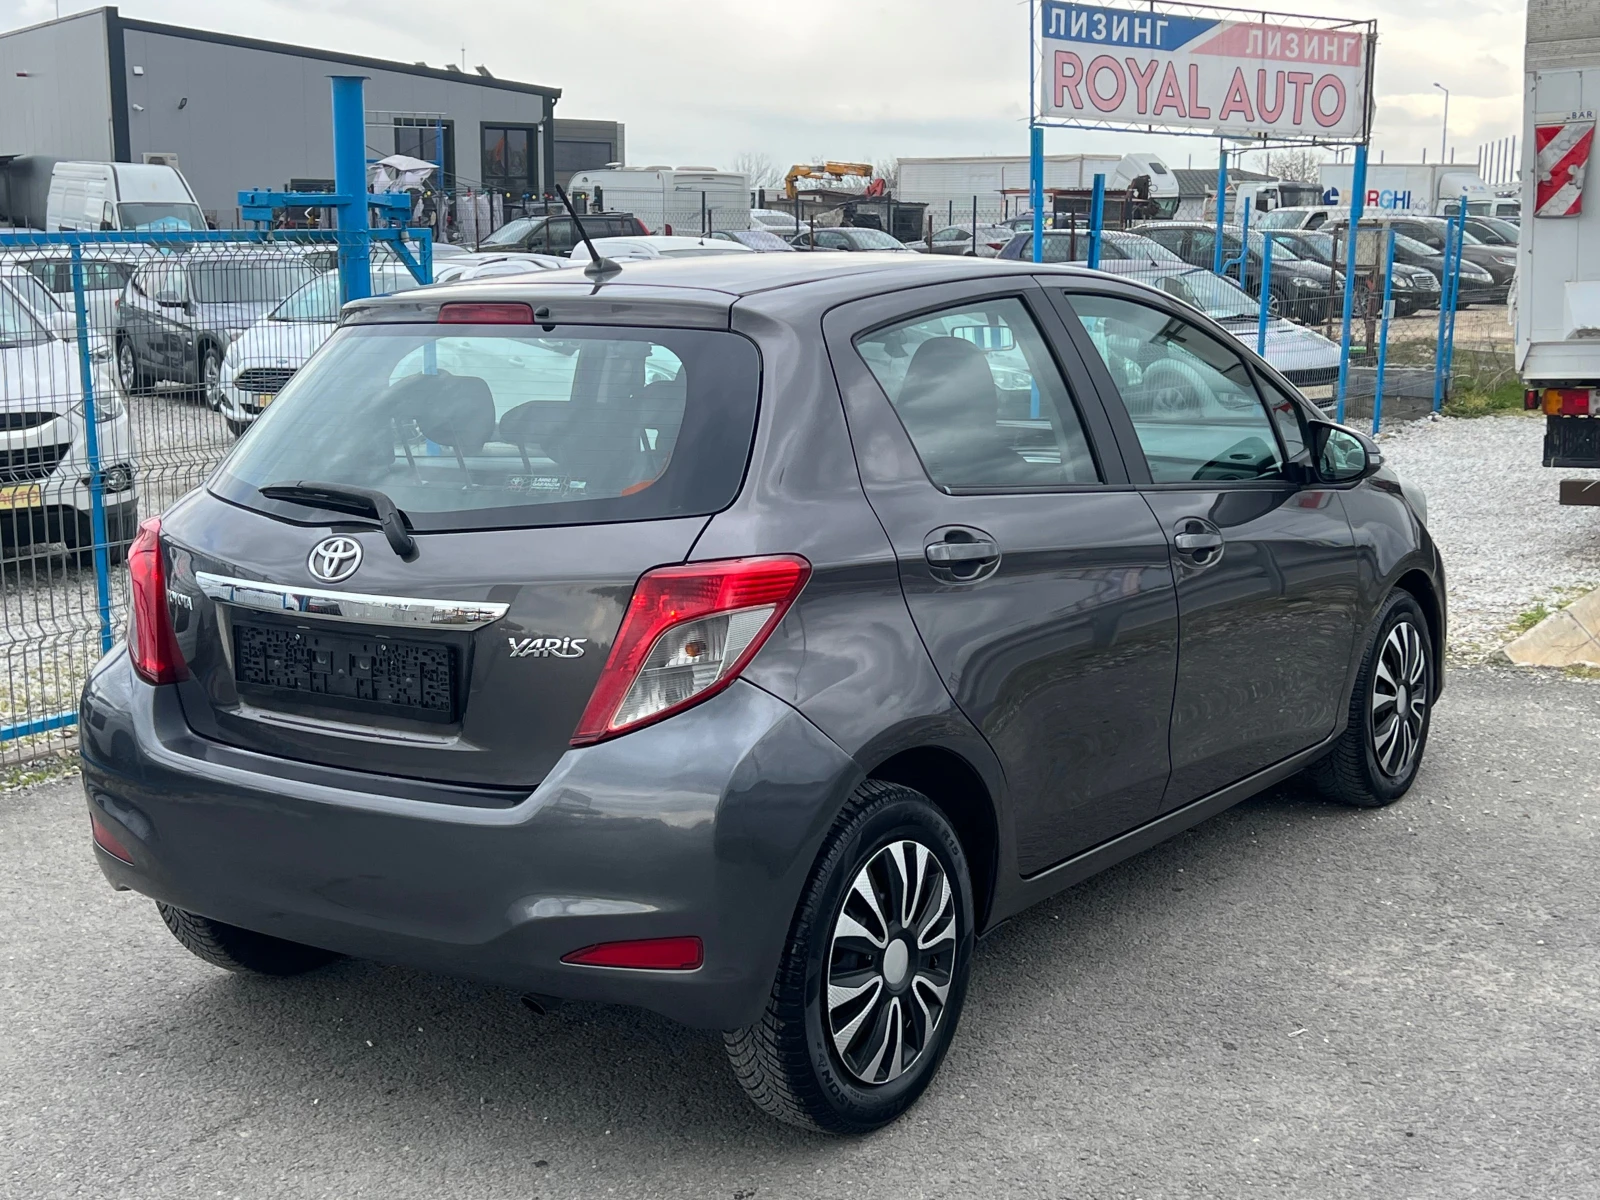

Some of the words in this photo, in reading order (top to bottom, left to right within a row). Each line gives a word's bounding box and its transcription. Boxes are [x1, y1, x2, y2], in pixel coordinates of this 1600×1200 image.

[1048, 8, 1169, 46] ЛИЗИНГ
[1246, 30, 1356, 63] ЛИЗИНГ
[1054, 50, 1211, 119] ROYAL
[1219, 66, 1347, 128] AUTO
[1342, 189, 1412, 210] BRGHI
